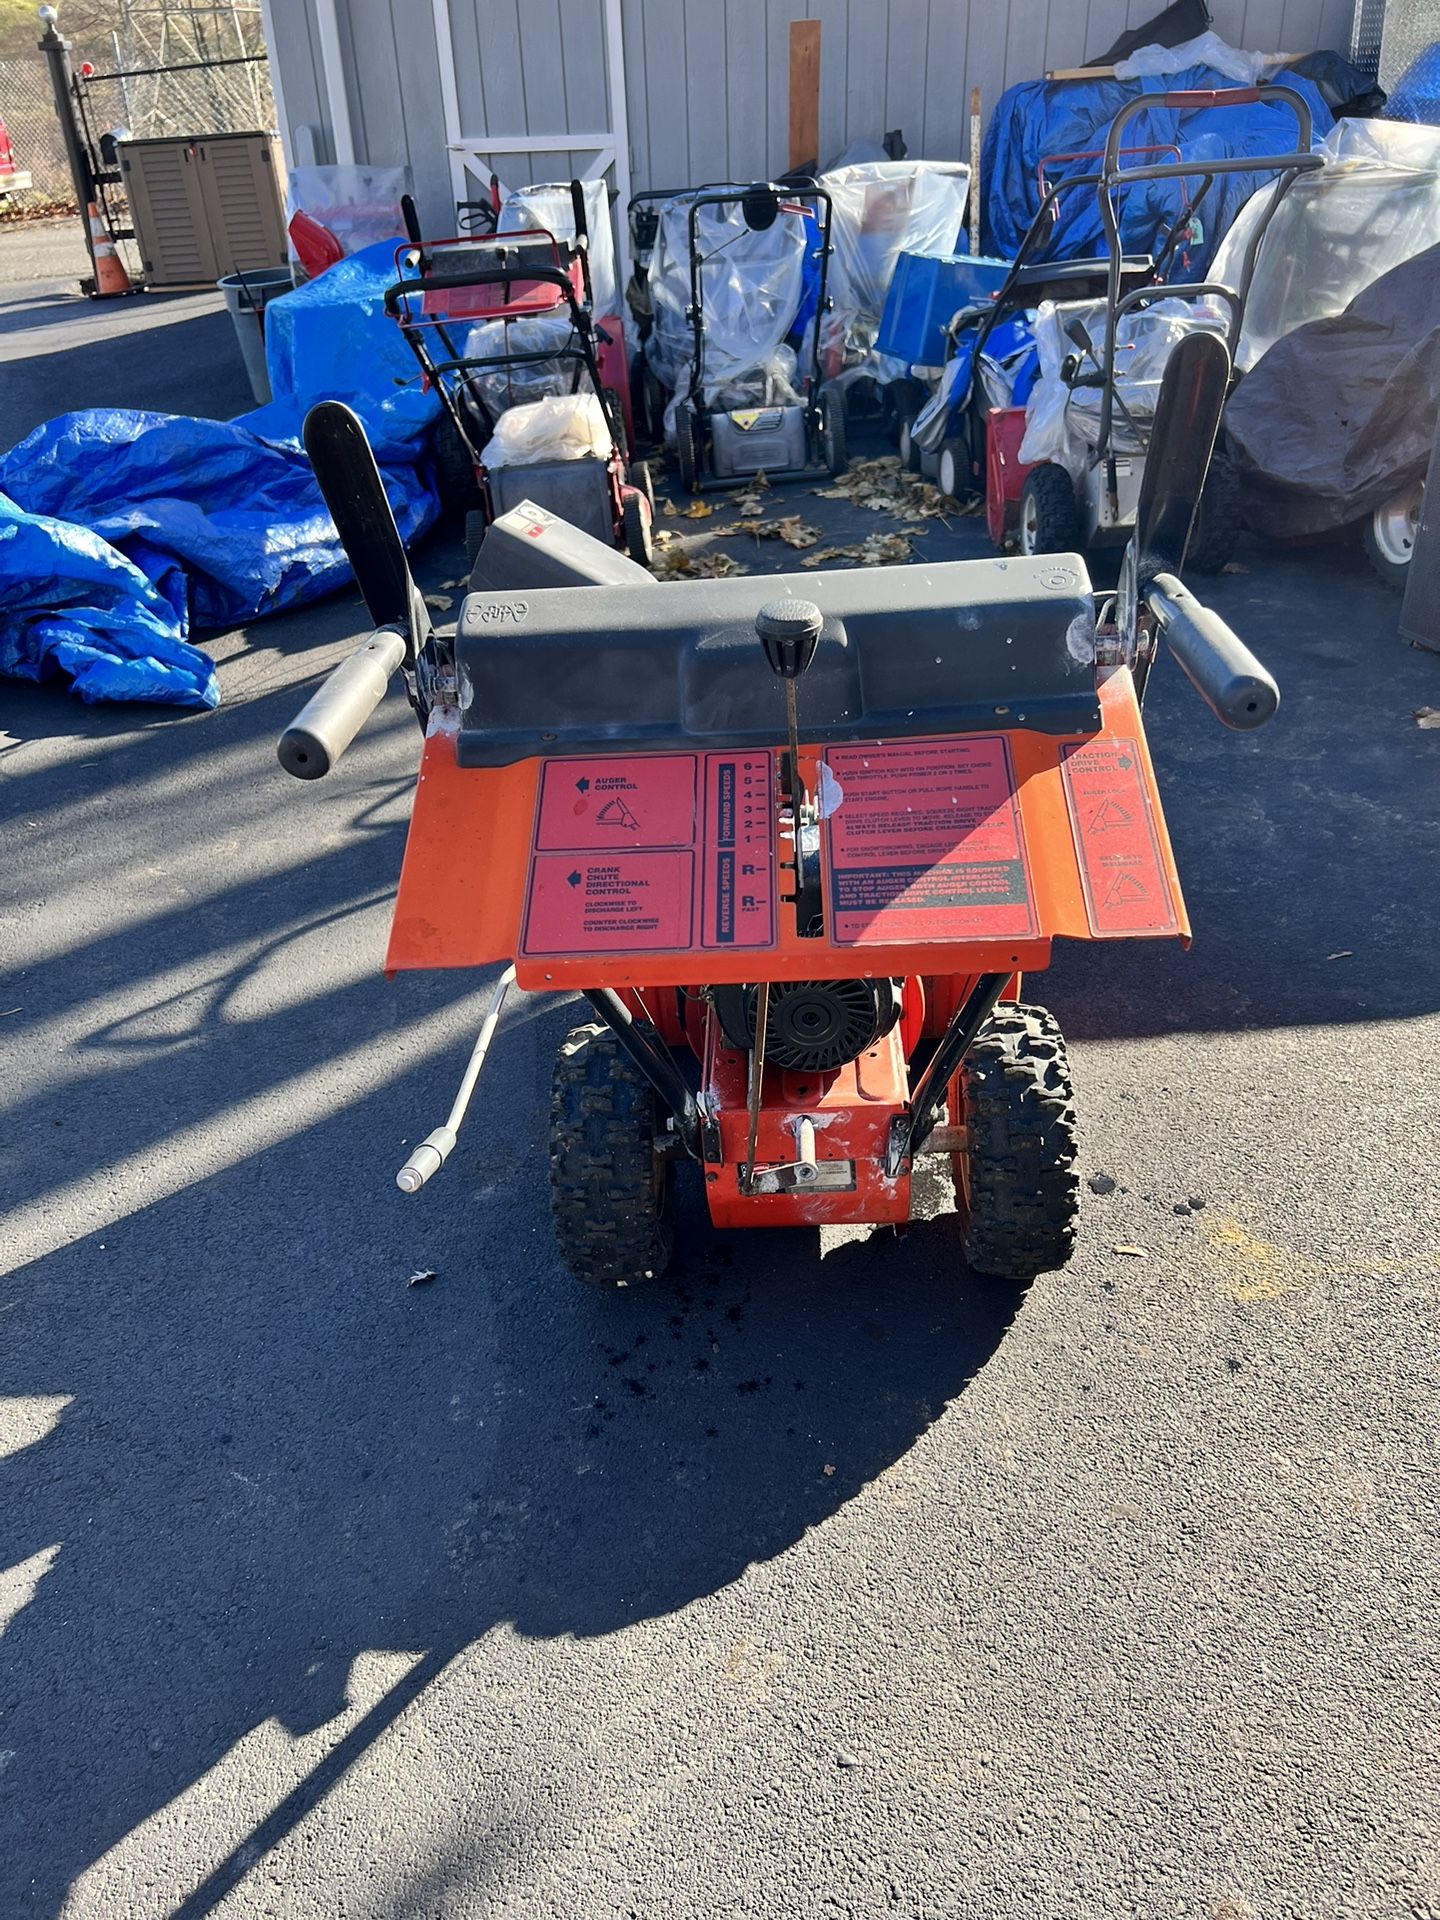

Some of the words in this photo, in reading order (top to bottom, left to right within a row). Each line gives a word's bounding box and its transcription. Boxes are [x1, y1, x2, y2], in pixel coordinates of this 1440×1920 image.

[744, 762, 752, 770] 6
[742, 865, 755, 875] R
[742, 896, 755, 906] R
[722, 892, 730, 933] REVERSE
